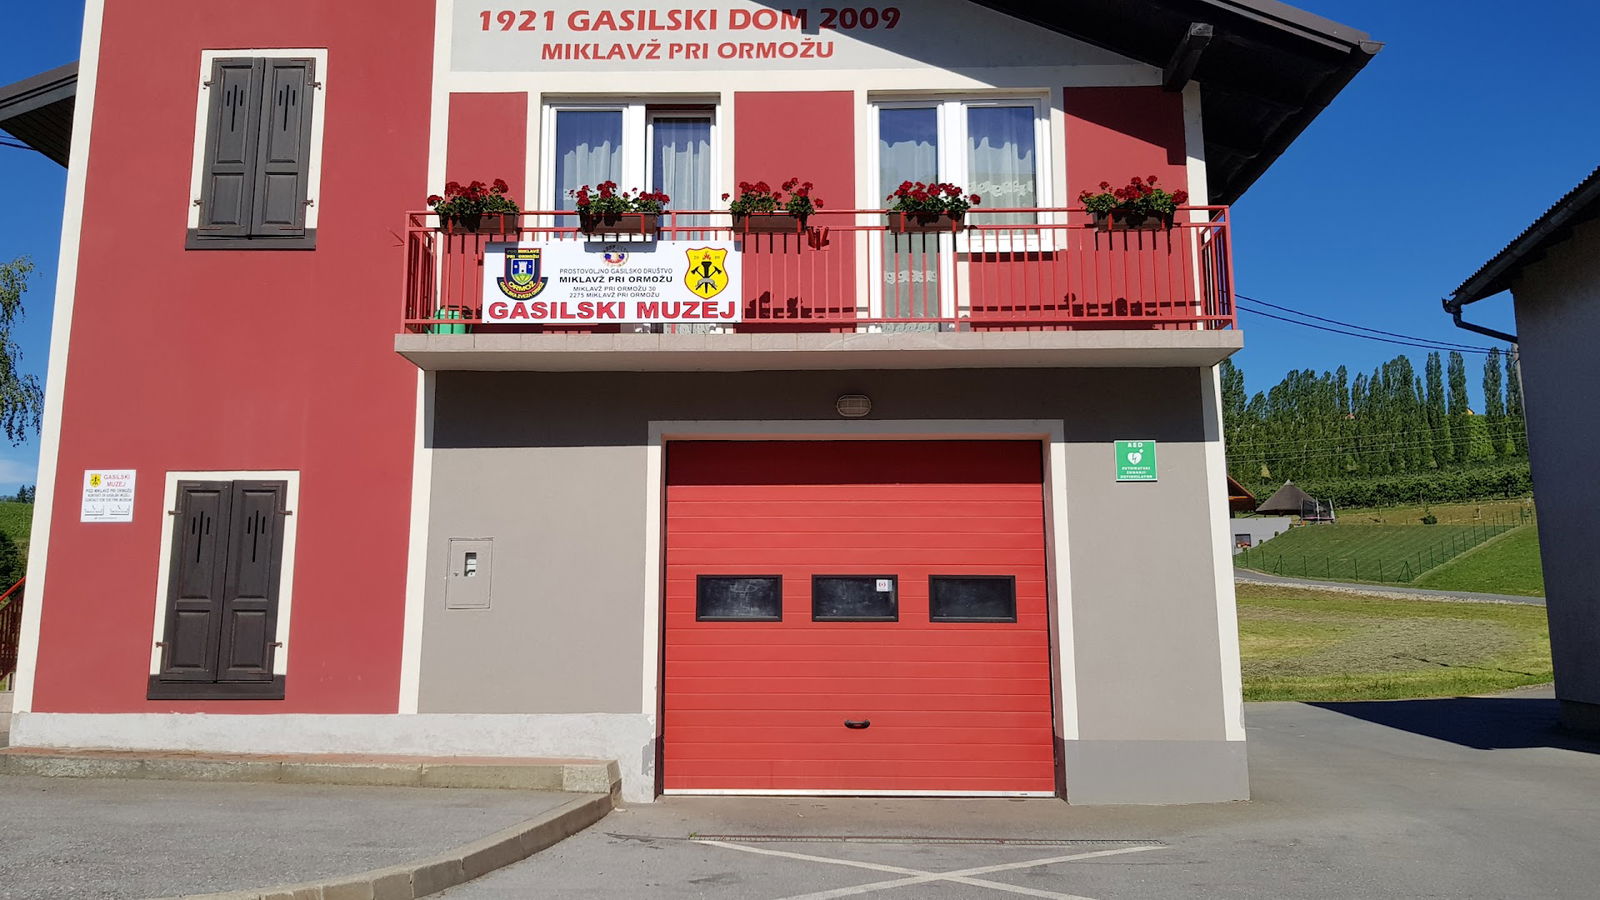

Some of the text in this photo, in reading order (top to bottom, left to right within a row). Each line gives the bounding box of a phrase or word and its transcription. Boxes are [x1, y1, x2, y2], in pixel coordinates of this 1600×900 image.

[480, 7, 901, 32] 1921 GASILSKI DOM 2009
[541, 38, 835, 61] MIKLAVŽ PRI ORMOŽU
[559, 267, 673, 275] PROSTOVOLJNO GASILSKO DRUŠTVO
[559, 275, 605, 283] MIKLAVŽ
[628, 275, 673, 283] ORMOŽU
[488, 301, 736, 320] GASILSKI MUZEJ
